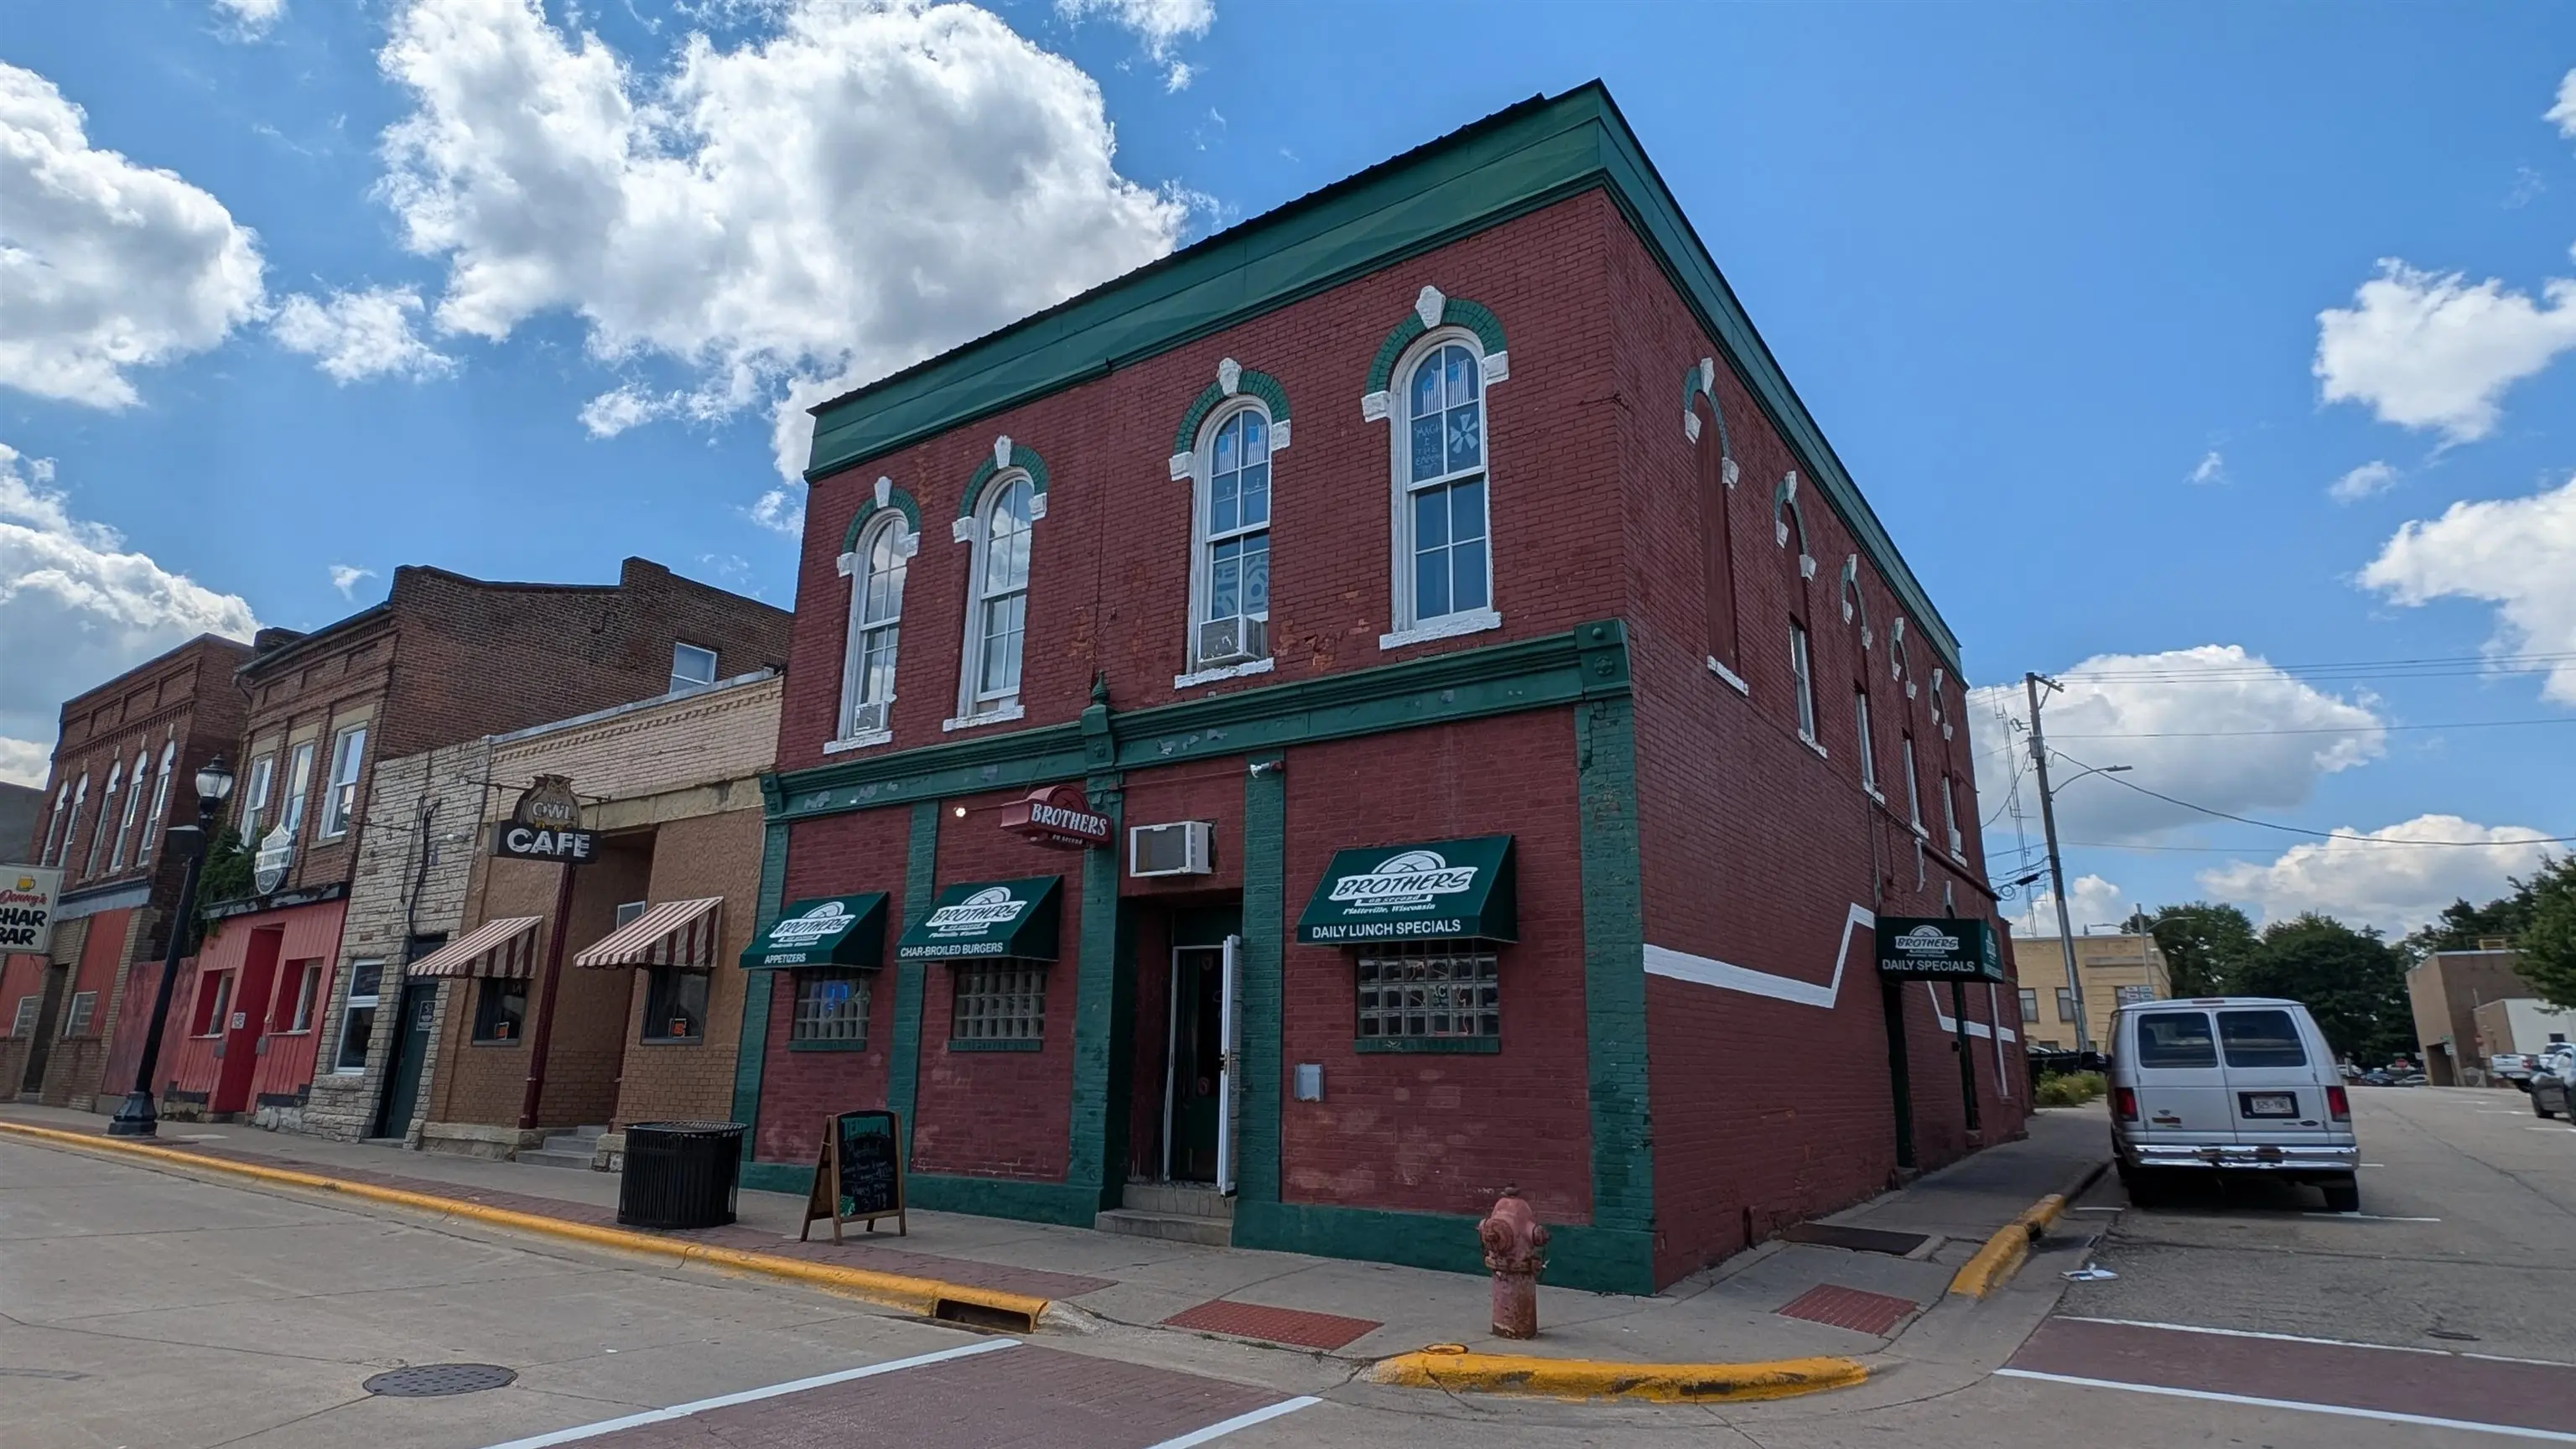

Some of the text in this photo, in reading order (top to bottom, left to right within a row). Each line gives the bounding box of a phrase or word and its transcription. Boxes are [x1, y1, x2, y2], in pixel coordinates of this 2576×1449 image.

[532, 802, 571, 819] OWL
[1031, 803, 1107, 836] BROTHERS
[506, 828, 591, 858] CAFE
[1337, 870, 1472, 896] BROTHERS
[932, 903, 1023, 922] BROTHERS
[774, 918, 851, 935] BROTHERS
[1311, 919, 1462, 938] DAILY LUNCH SPECIALS
[901, 942, 1004, 957] CHAR-BROILED BURGERS
[1897, 937, 1959, 948] BROTHERS
[764, 953, 807, 964] APPETIZERS
[1882, 958, 1914, 971] DAILY
[1916, 959, 1976, 973] SPECIALS
